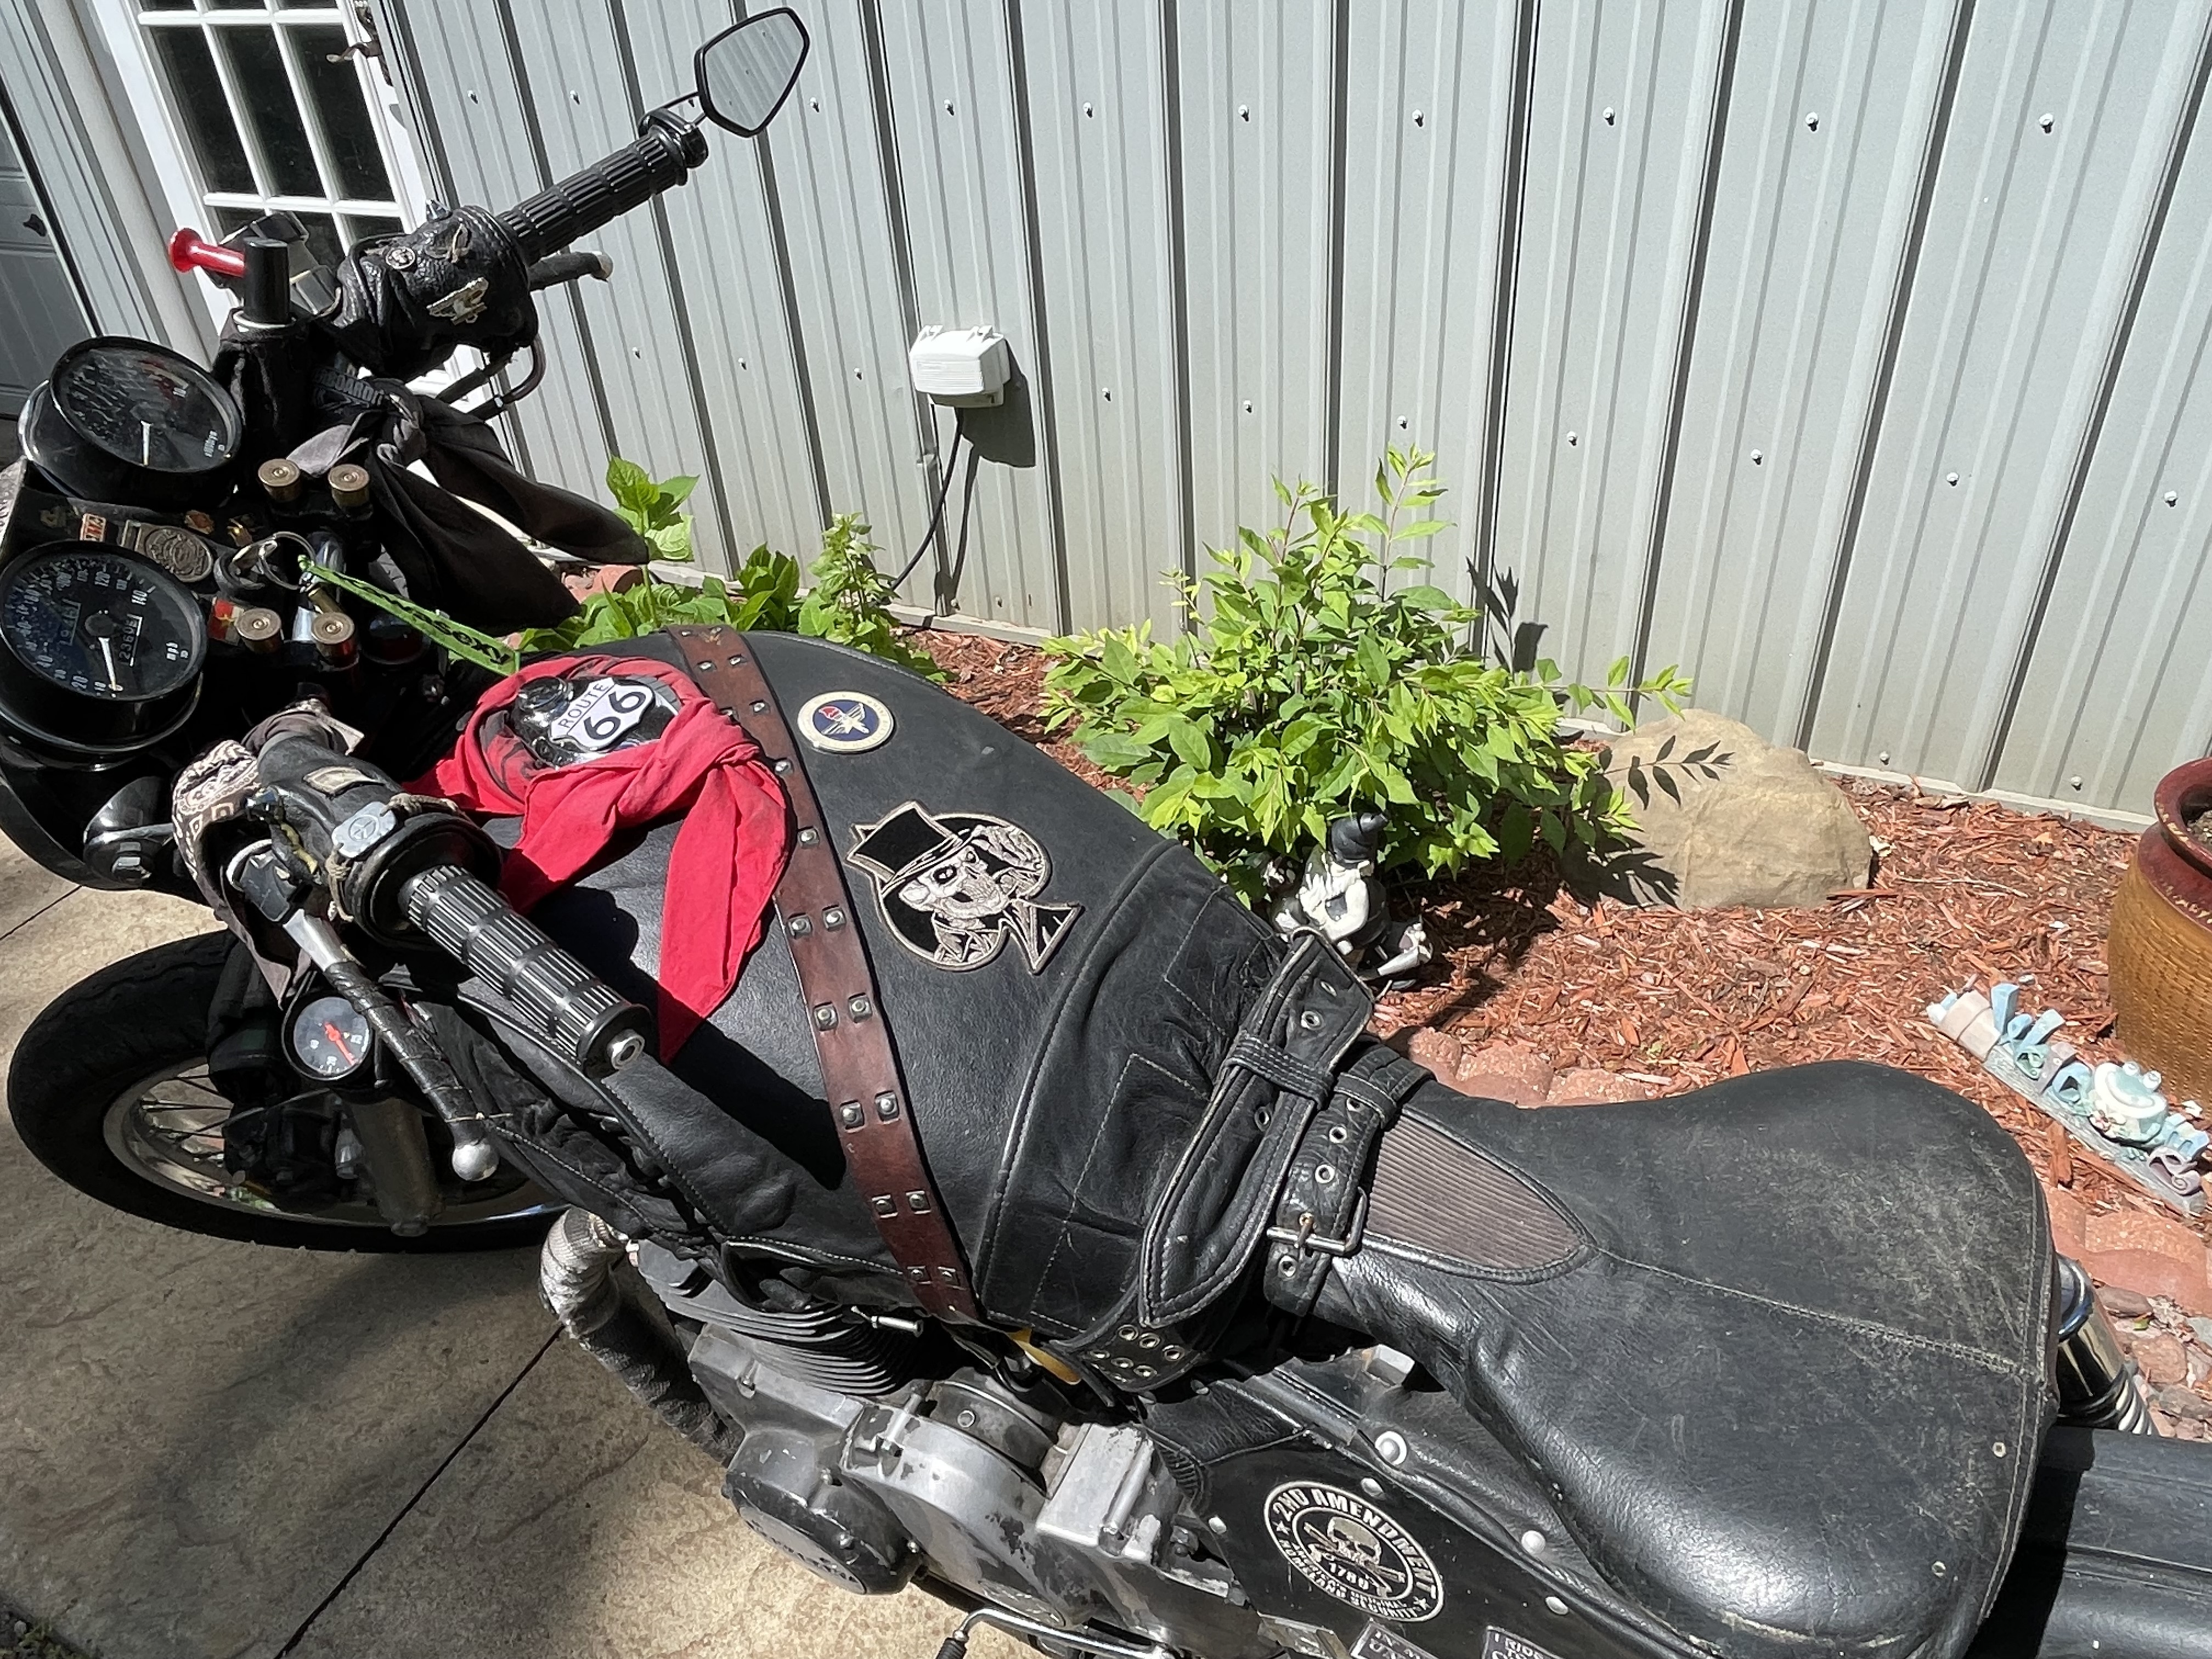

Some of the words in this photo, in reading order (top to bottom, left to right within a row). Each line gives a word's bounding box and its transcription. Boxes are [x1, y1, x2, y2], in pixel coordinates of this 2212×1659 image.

[558, 684, 610, 729] ROUTE
[584, 691, 647, 741] 66
[1991, 983, 2209, 1197] Welcme
[1272, 1488, 1310, 1522] 2ND
[1311, 1488, 1437, 1600] AMENDMENT
